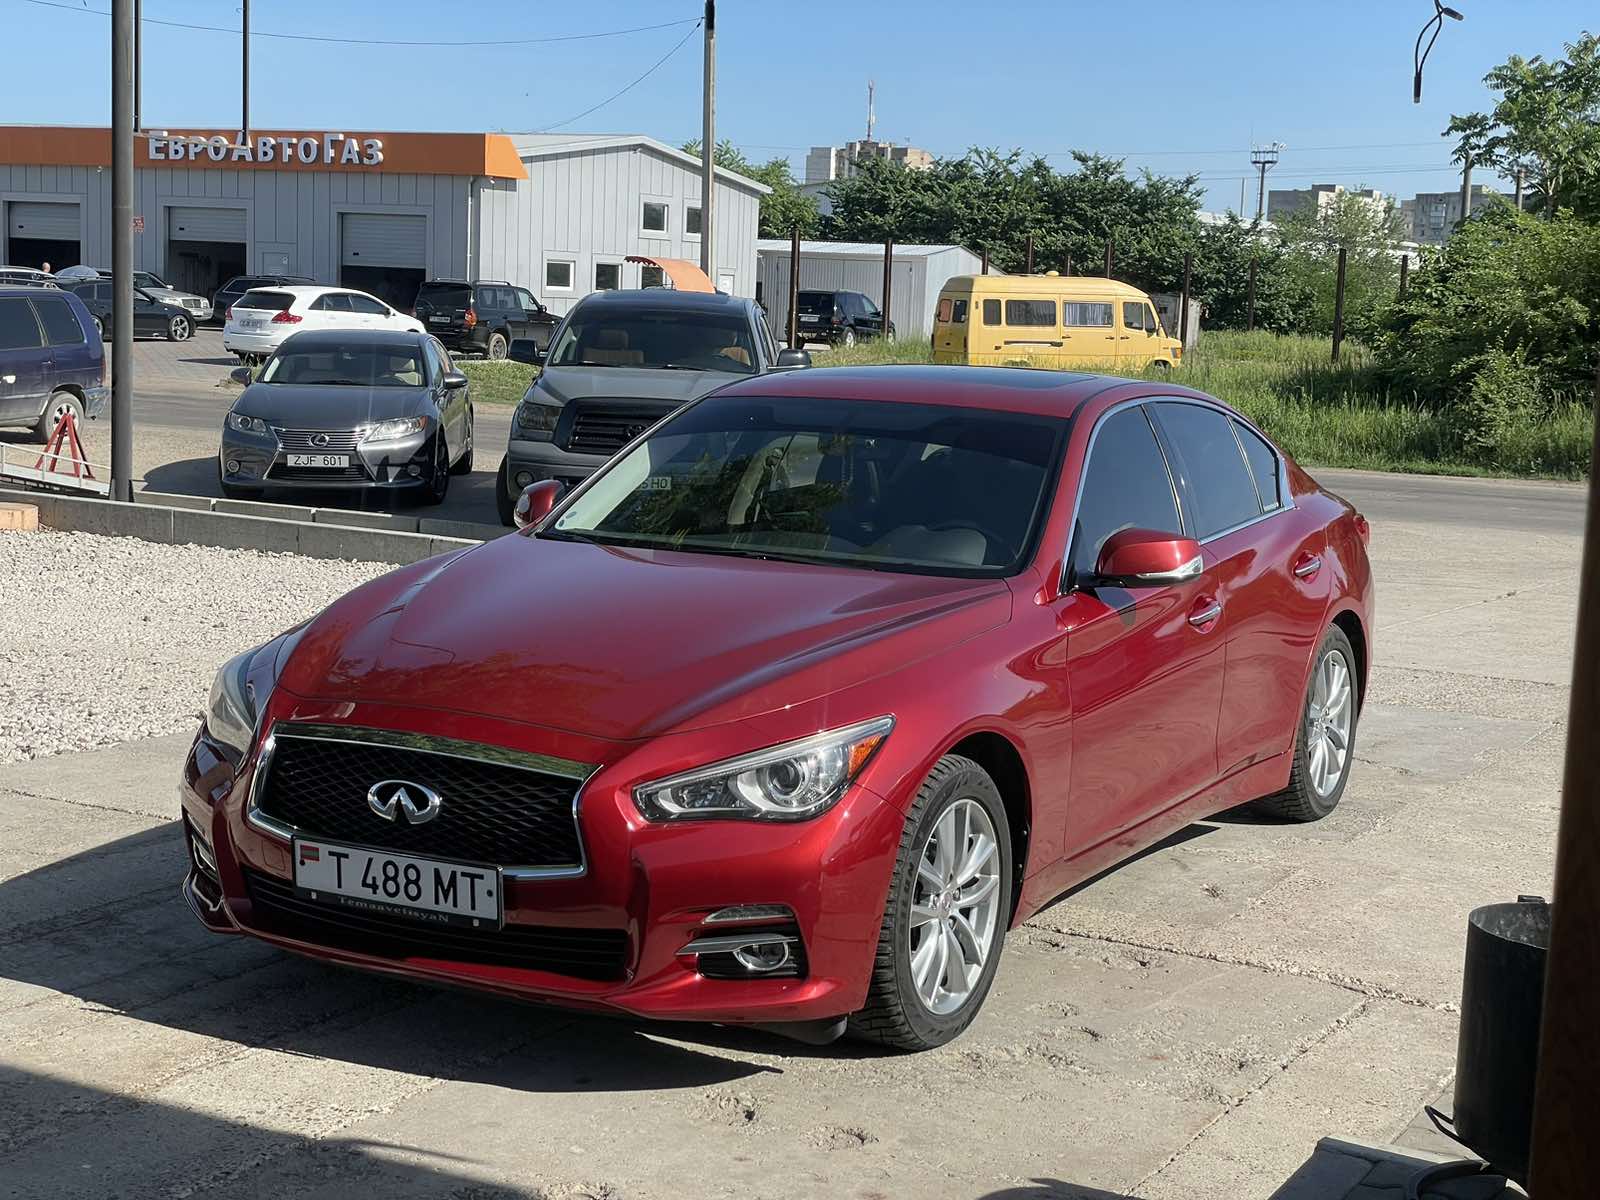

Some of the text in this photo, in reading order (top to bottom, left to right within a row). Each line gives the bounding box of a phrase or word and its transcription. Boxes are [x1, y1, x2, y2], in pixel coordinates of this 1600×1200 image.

[294, 455, 342, 466] ZJF 601
[328, 850, 484, 911] T 488 MT
